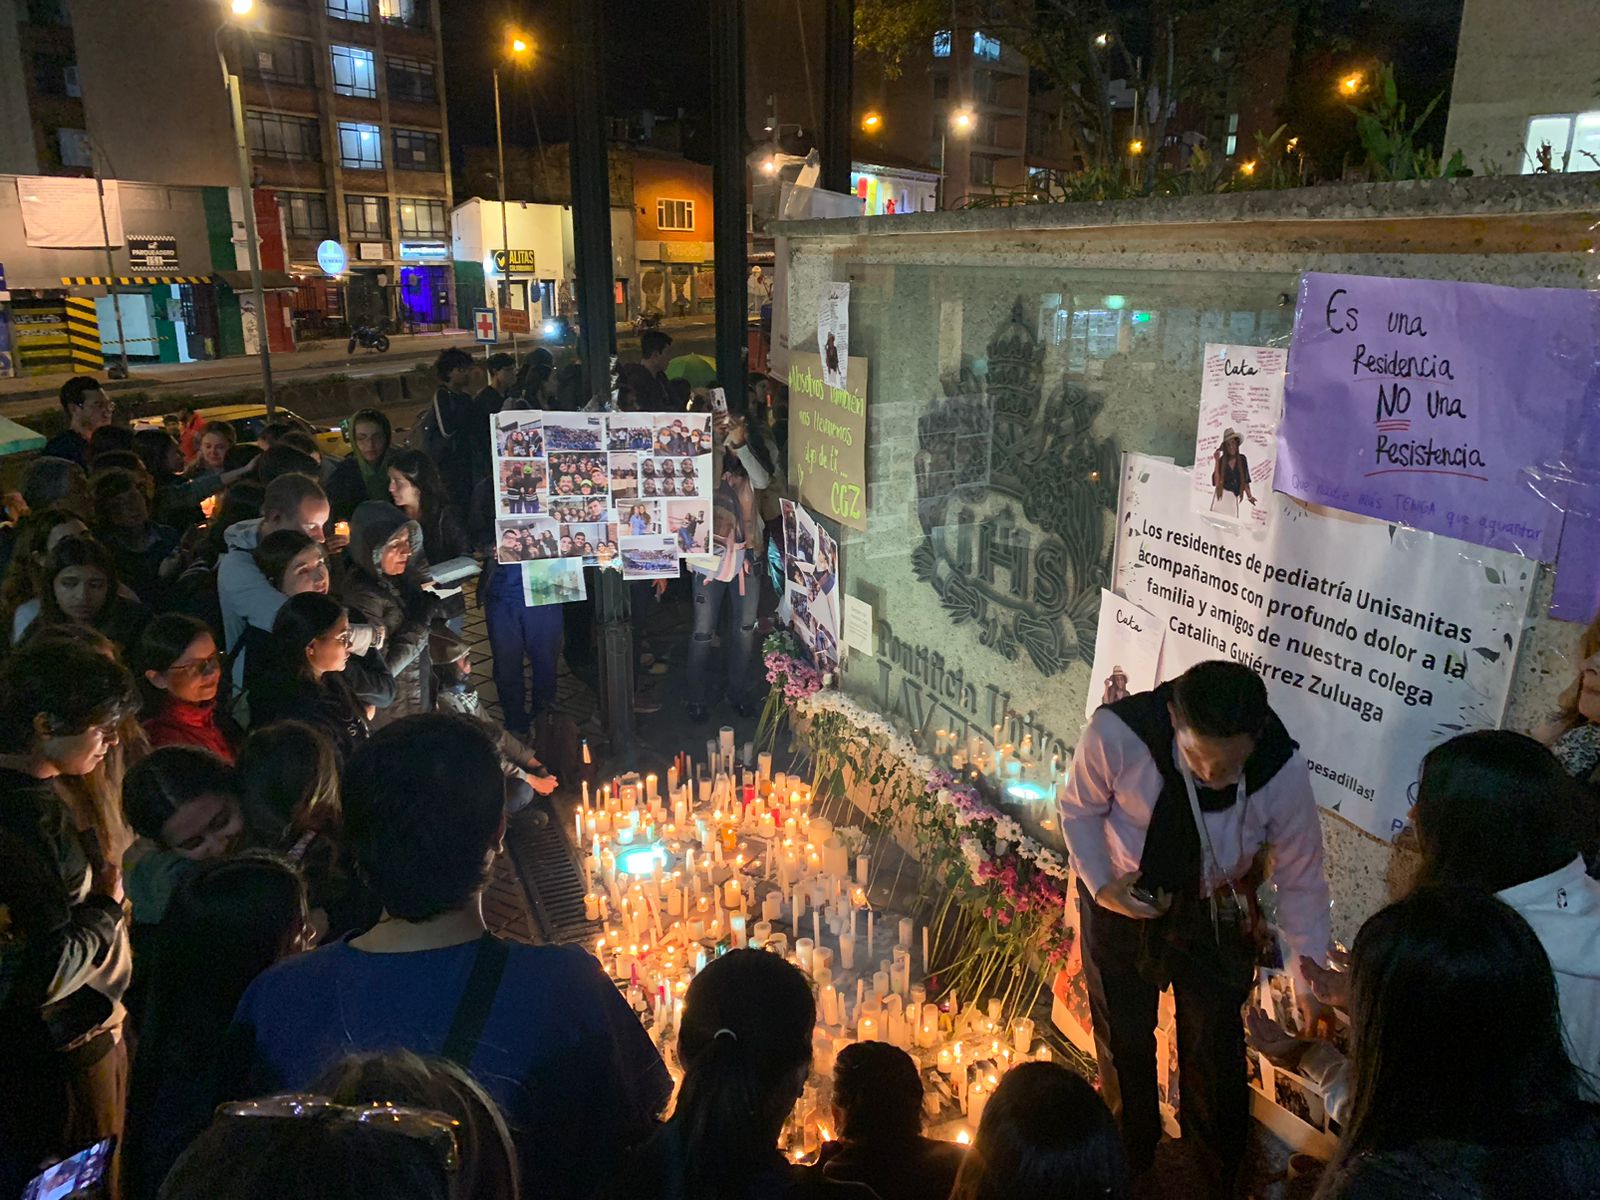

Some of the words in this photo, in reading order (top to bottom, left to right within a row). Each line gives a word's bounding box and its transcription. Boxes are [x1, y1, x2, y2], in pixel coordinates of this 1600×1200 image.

[509, 250, 534, 264] ALITAS
[1325, 288, 1359, 334] Es
[1387, 310, 1427, 338] una
[1352, 343, 1455, 381] Residencia
[1375, 384, 1411, 421] NO
[818, 444, 828, 469] de
[1375, 435, 1486, 469] Resistencia
[831, 480, 861, 520] CGZ
[1291, 473, 1310, 492] Que
[1393, 494, 1437, 517] TENGA
[1446, 510, 1470, 528] que
[1479, 515, 1543, 541] aguantar
[1142, 518, 1163, 540] Los
[1166, 529, 1242, 566] residentes
[1245, 553, 1262, 574] de
[1263, 563, 1352, 604] pediatría
[1356, 589, 1473, 644] Unisanitas
[1116, 609, 1143, 632] Cata
[1138, 548, 1239, 596] acompañamos
[1241, 588, 1264, 609] con
[1266, 598, 1358, 641] profundo
[1364, 628, 1417, 663] dolor
[1422, 653, 1436, 670] a
[1443, 654, 1466, 680] la
[1146, 577, 1194, 609] familia
[1197, 598, 1208, 617] y
[1210, 604, 1255, 638] amigos
[1257, 625, 1279, 648] de
[1286, 638, 1363, 678] nuestra
[1368, 668, 1434, 707] colega
[877, 620, 978, 714] Pontificia
[1168, 616, 1227, 654] Catalina
[1230, 642, 1305, 690] Gutiérrez
[1307, 674, 1384, 724] Zuluaga
[1306, 758, 1376, 802] pesadillas!
